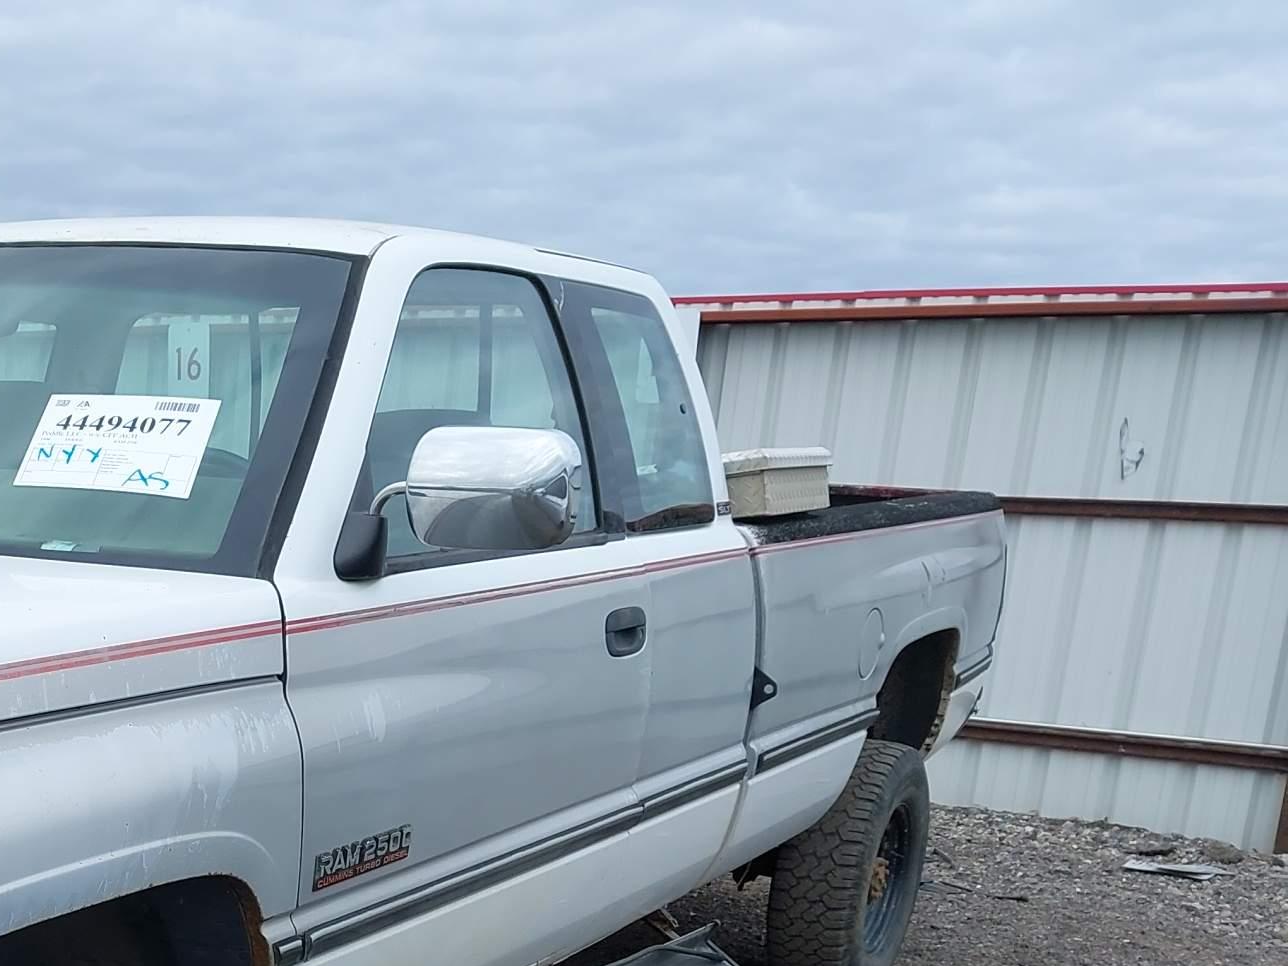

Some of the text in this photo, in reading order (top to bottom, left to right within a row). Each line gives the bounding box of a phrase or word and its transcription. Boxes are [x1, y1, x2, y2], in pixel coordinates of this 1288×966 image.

[175, 346, 202, 381] 16
[55, 414, 192, 437] 44494077
[317, 868, 354, 889] CUMMINS
[355, 858, 381, 874] TURBO
[319, 844, 362, 877] RAM
